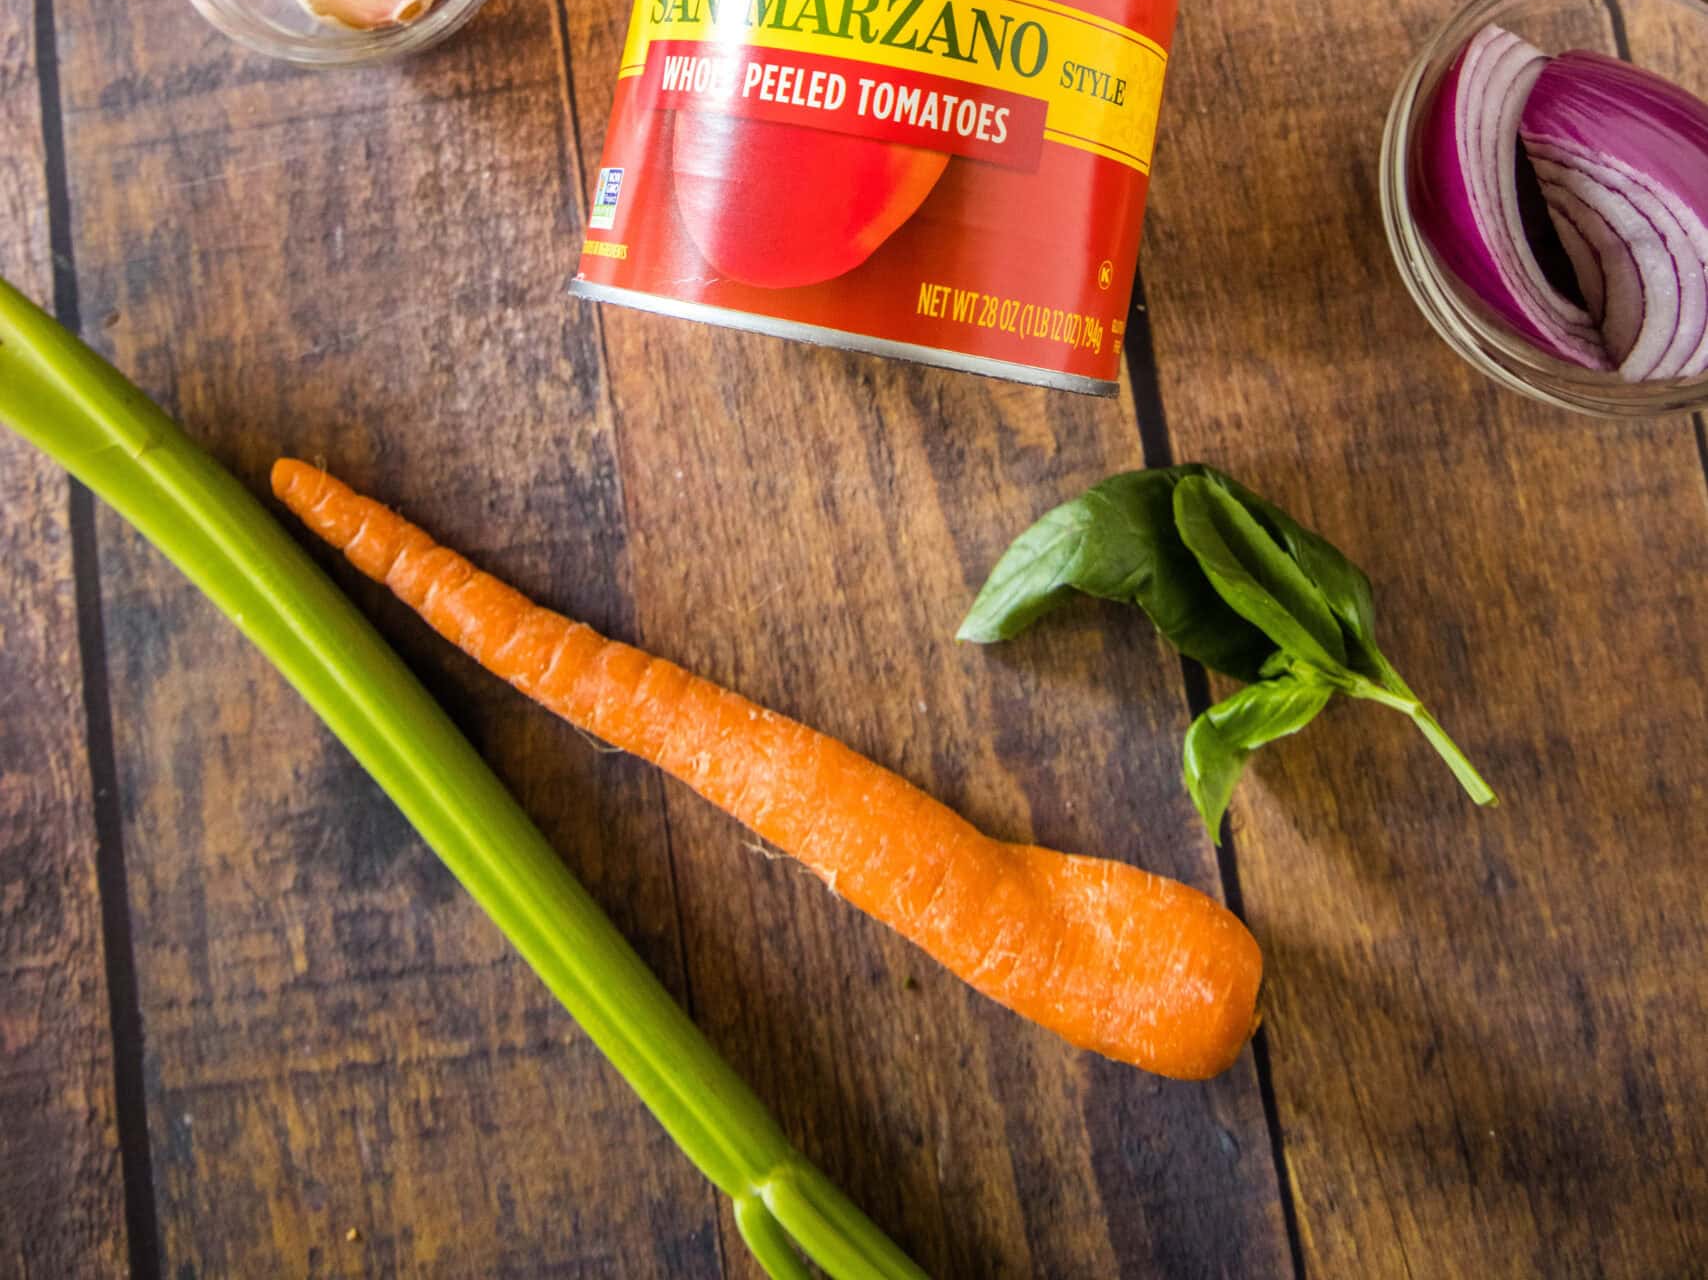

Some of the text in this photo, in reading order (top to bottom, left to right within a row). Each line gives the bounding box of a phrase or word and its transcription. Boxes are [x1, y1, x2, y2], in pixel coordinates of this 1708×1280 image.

[661, 55, 1010, 144] WHO PEELED TOMATOES
[1060, 60, 1127, 107] STYLE
[916, 282, 952, 318] NET
[952, 289, 979, 324] WT
[978, 295, 999, 328] 28
[999, 299, 1021, 333] OZ
[1019, 303, 1034, 340] (1
[1034, 306, 1051, 338] LB
[1050, 308, 1064, 341] 12
[1063, 311, 1082, 350] OZ)
[1081, 316, 1103, 355] 794g
